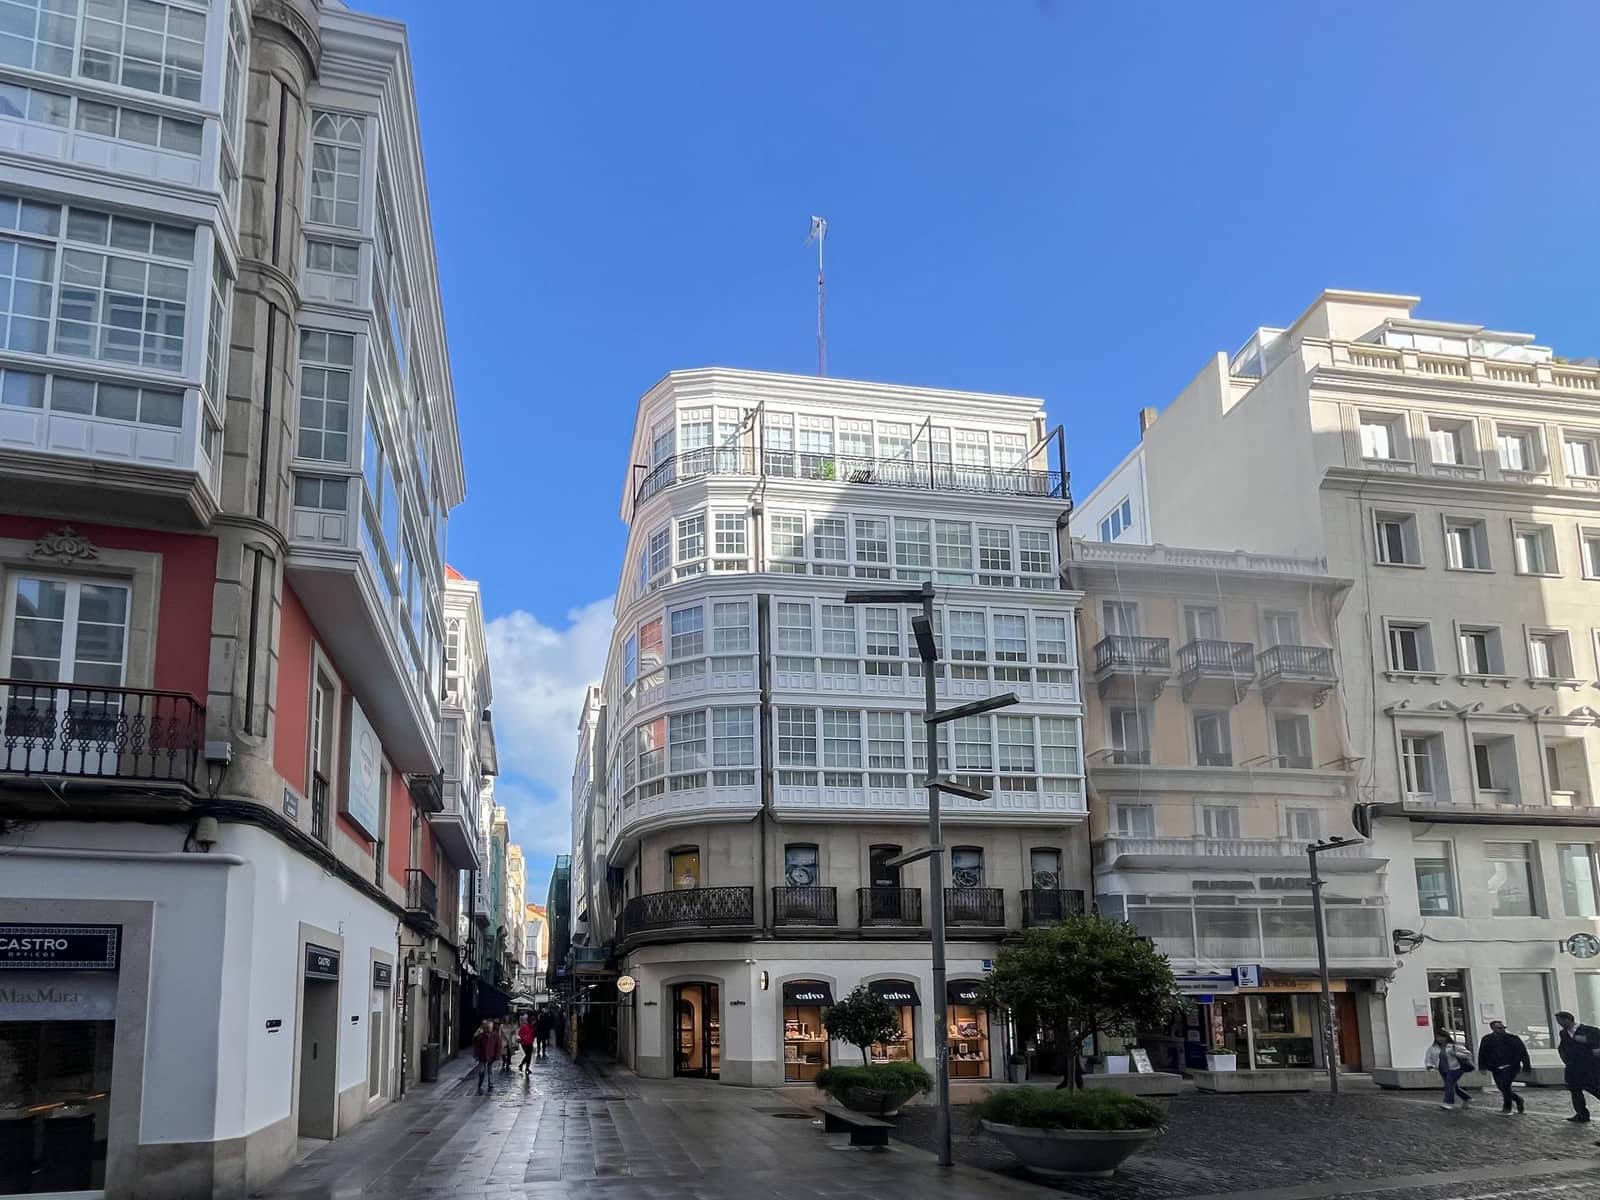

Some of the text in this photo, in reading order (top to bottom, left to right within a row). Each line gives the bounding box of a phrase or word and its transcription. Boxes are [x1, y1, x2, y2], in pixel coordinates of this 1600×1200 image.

[0, 938, 68, 950] CASTRO
[1440, 977, 1446, 987] 2
[796, 992, 824, 1001] calvo
[883, 992, 911, 1001] calvo
